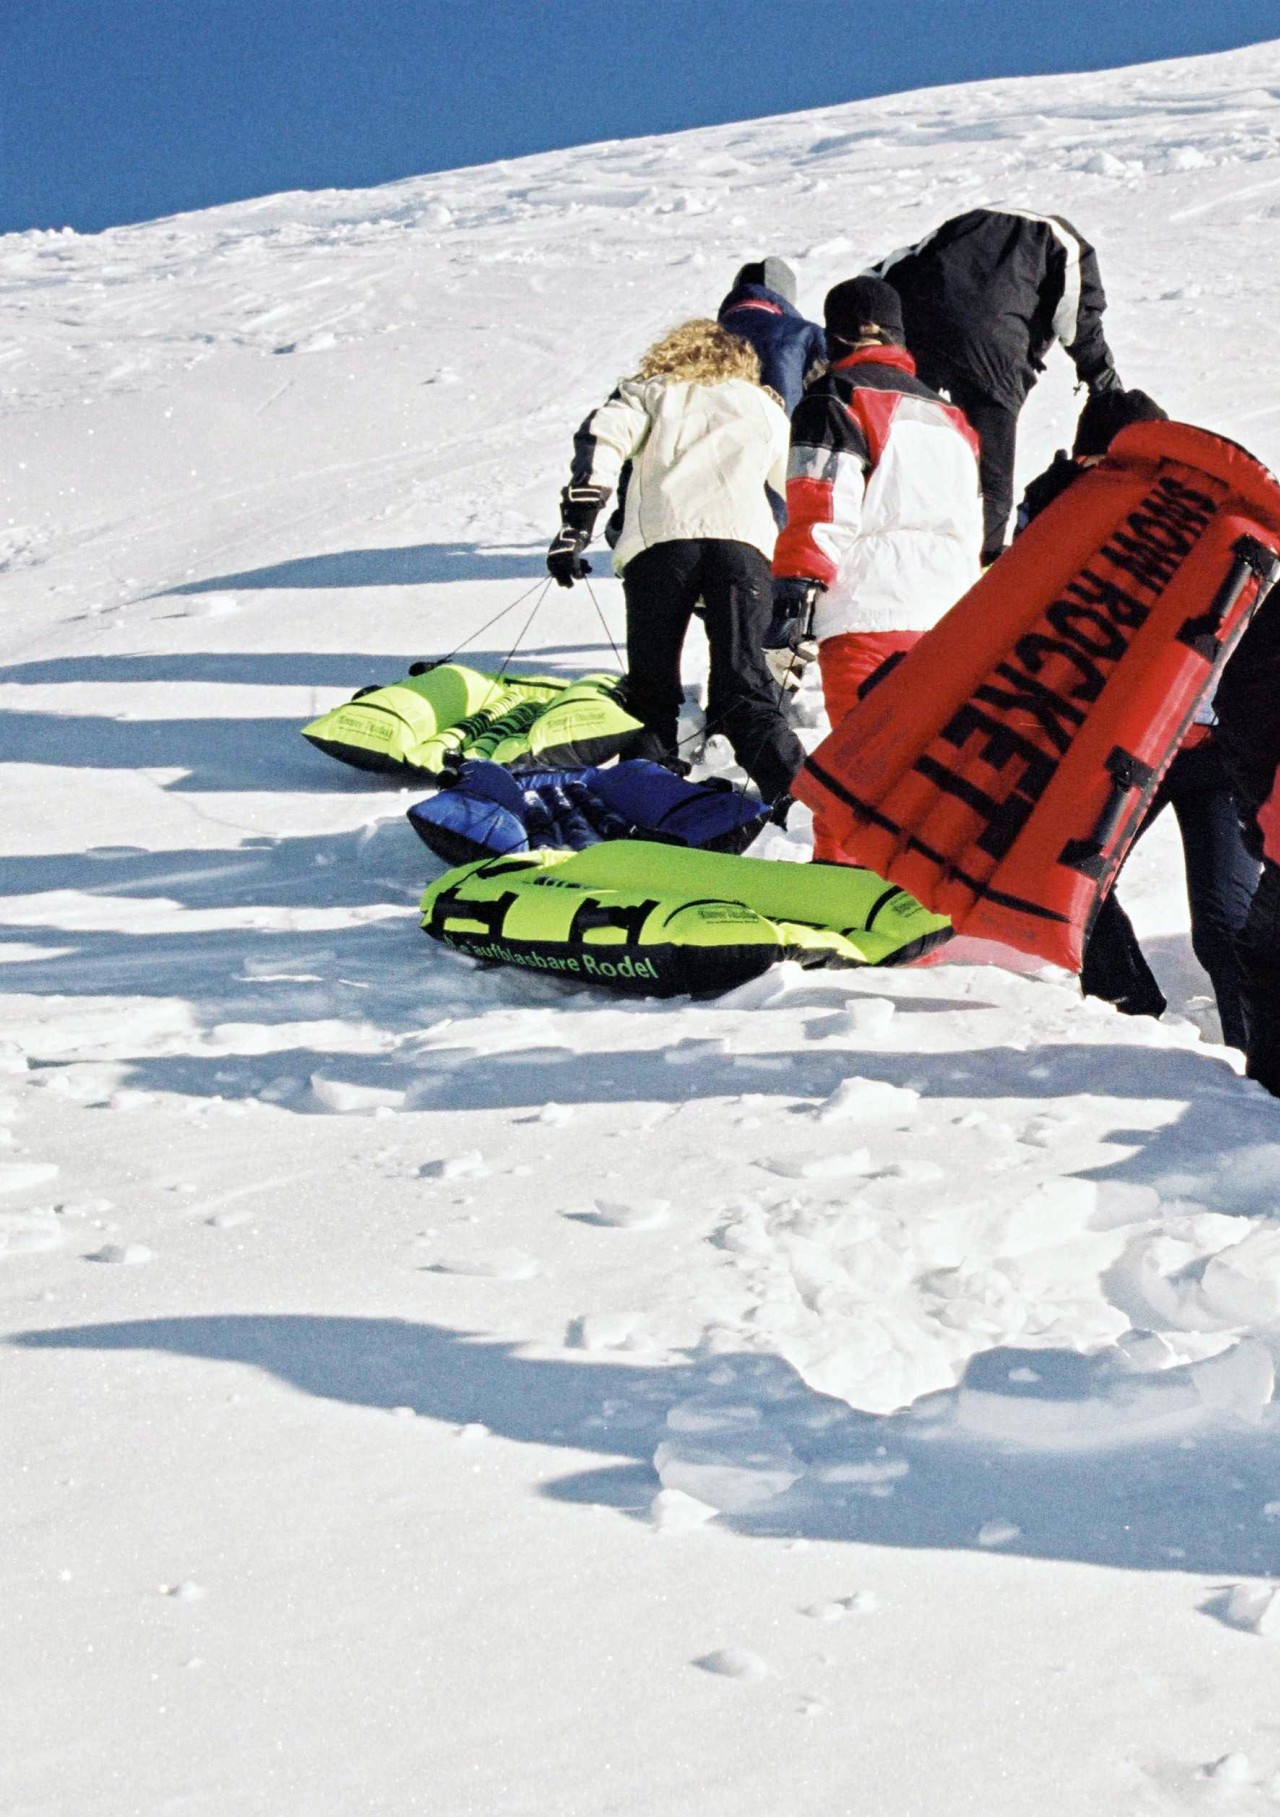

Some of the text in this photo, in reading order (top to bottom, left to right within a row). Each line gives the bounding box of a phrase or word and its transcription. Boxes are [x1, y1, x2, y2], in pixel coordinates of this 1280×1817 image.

[914, 475, 1220, 861] SNOW ROCKET
[472, 942, 580, 972] aufblasbare
[582, 953, 659, 979] Rodel
